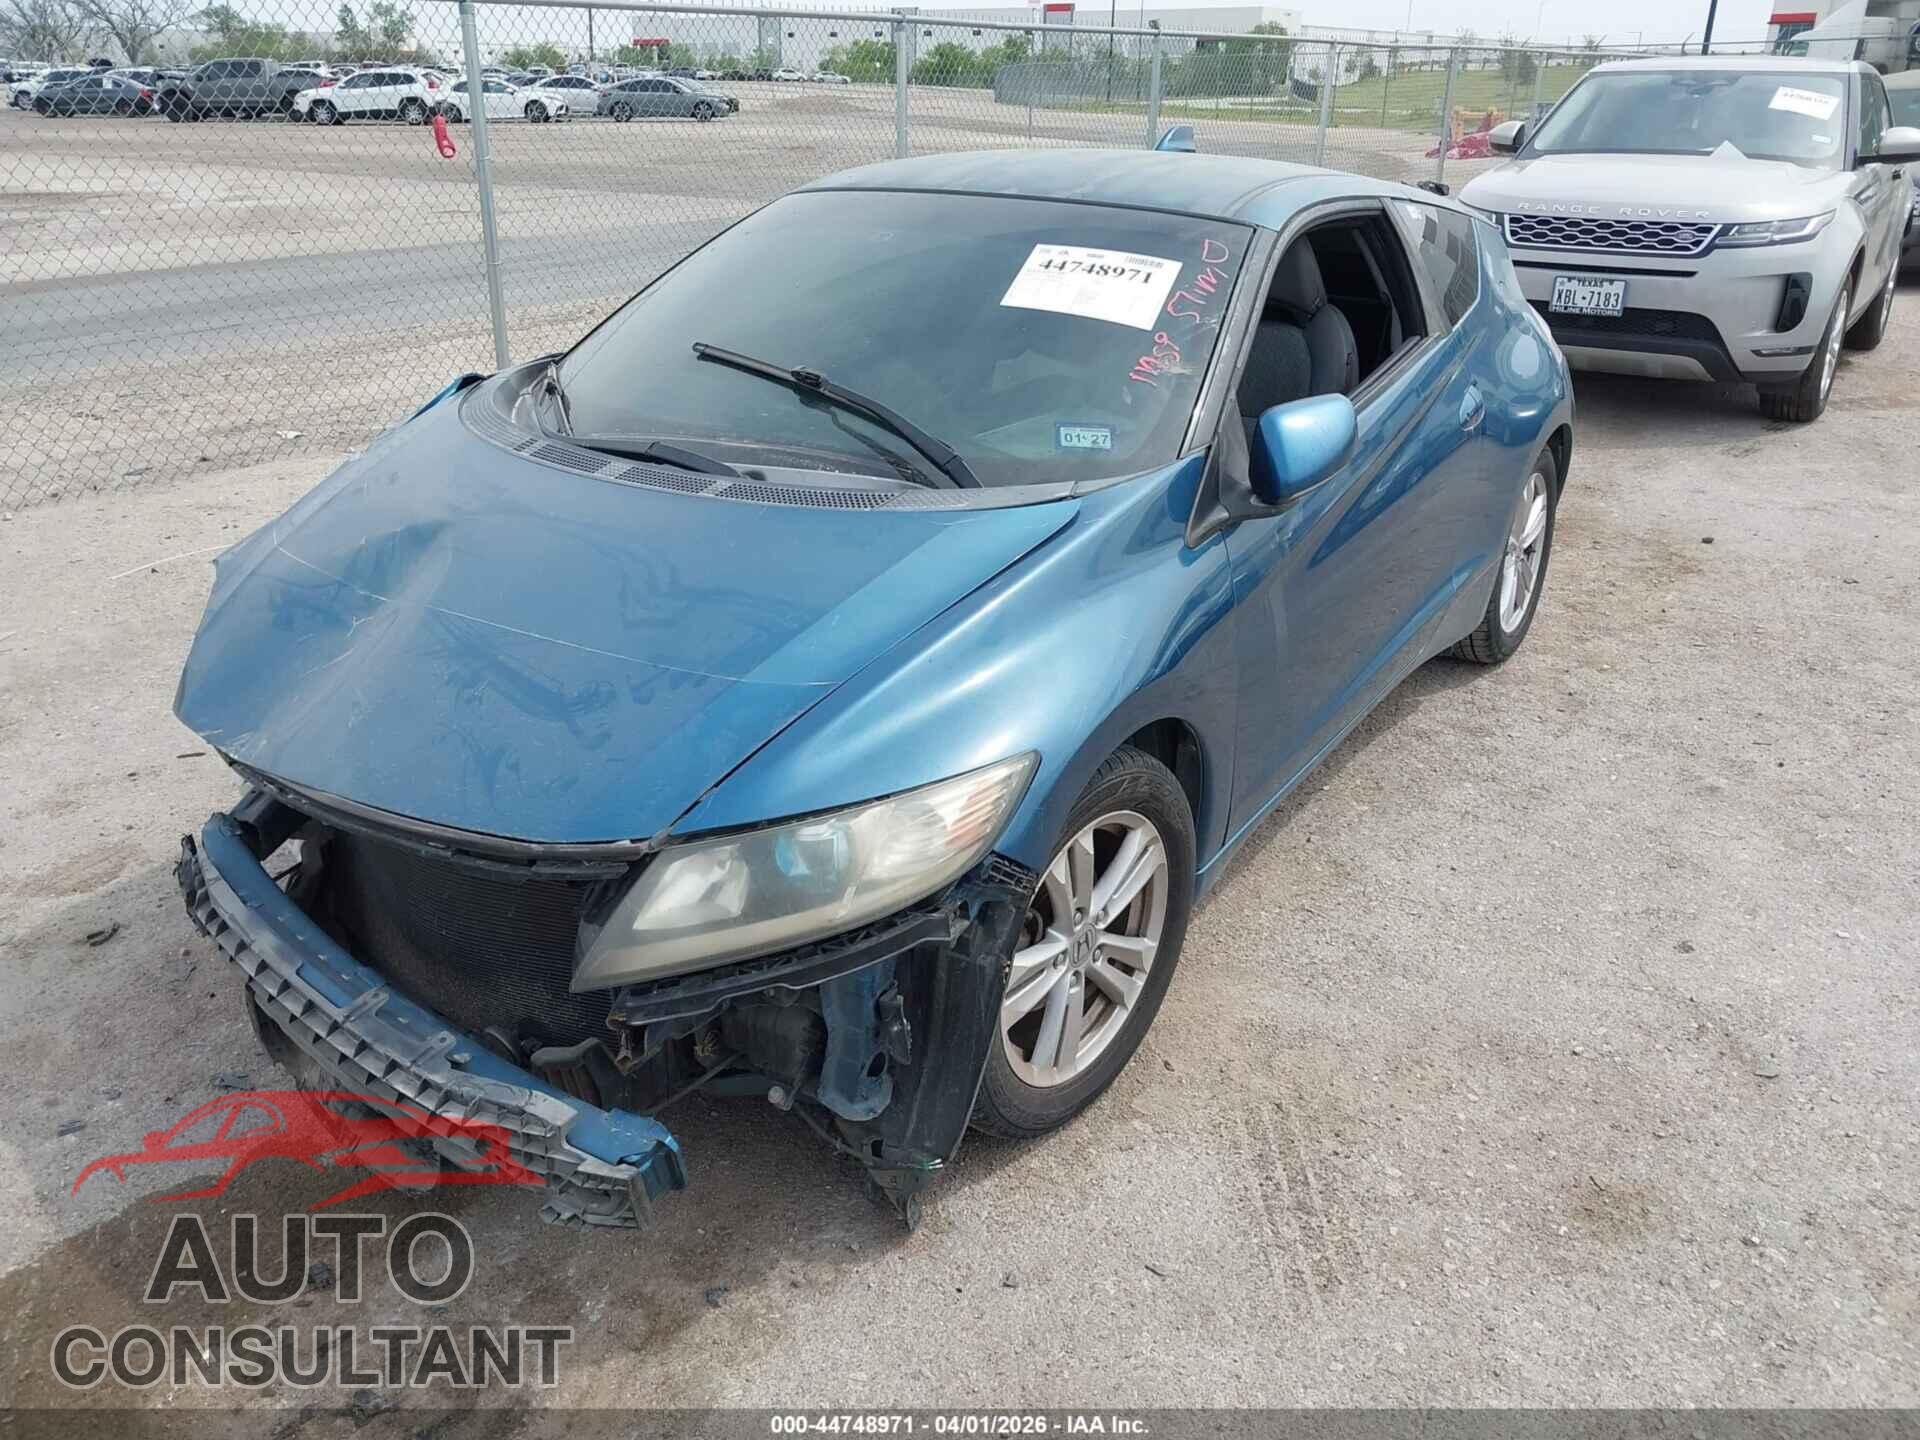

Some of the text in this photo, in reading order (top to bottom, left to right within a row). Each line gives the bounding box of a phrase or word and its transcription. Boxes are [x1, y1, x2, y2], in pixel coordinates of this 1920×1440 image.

[1517, 202, 1710, 219] RANGE ROVER
[1039, 258, 1153, 284] 44748971
[1576, 277, 1604, 288] TEXAS
